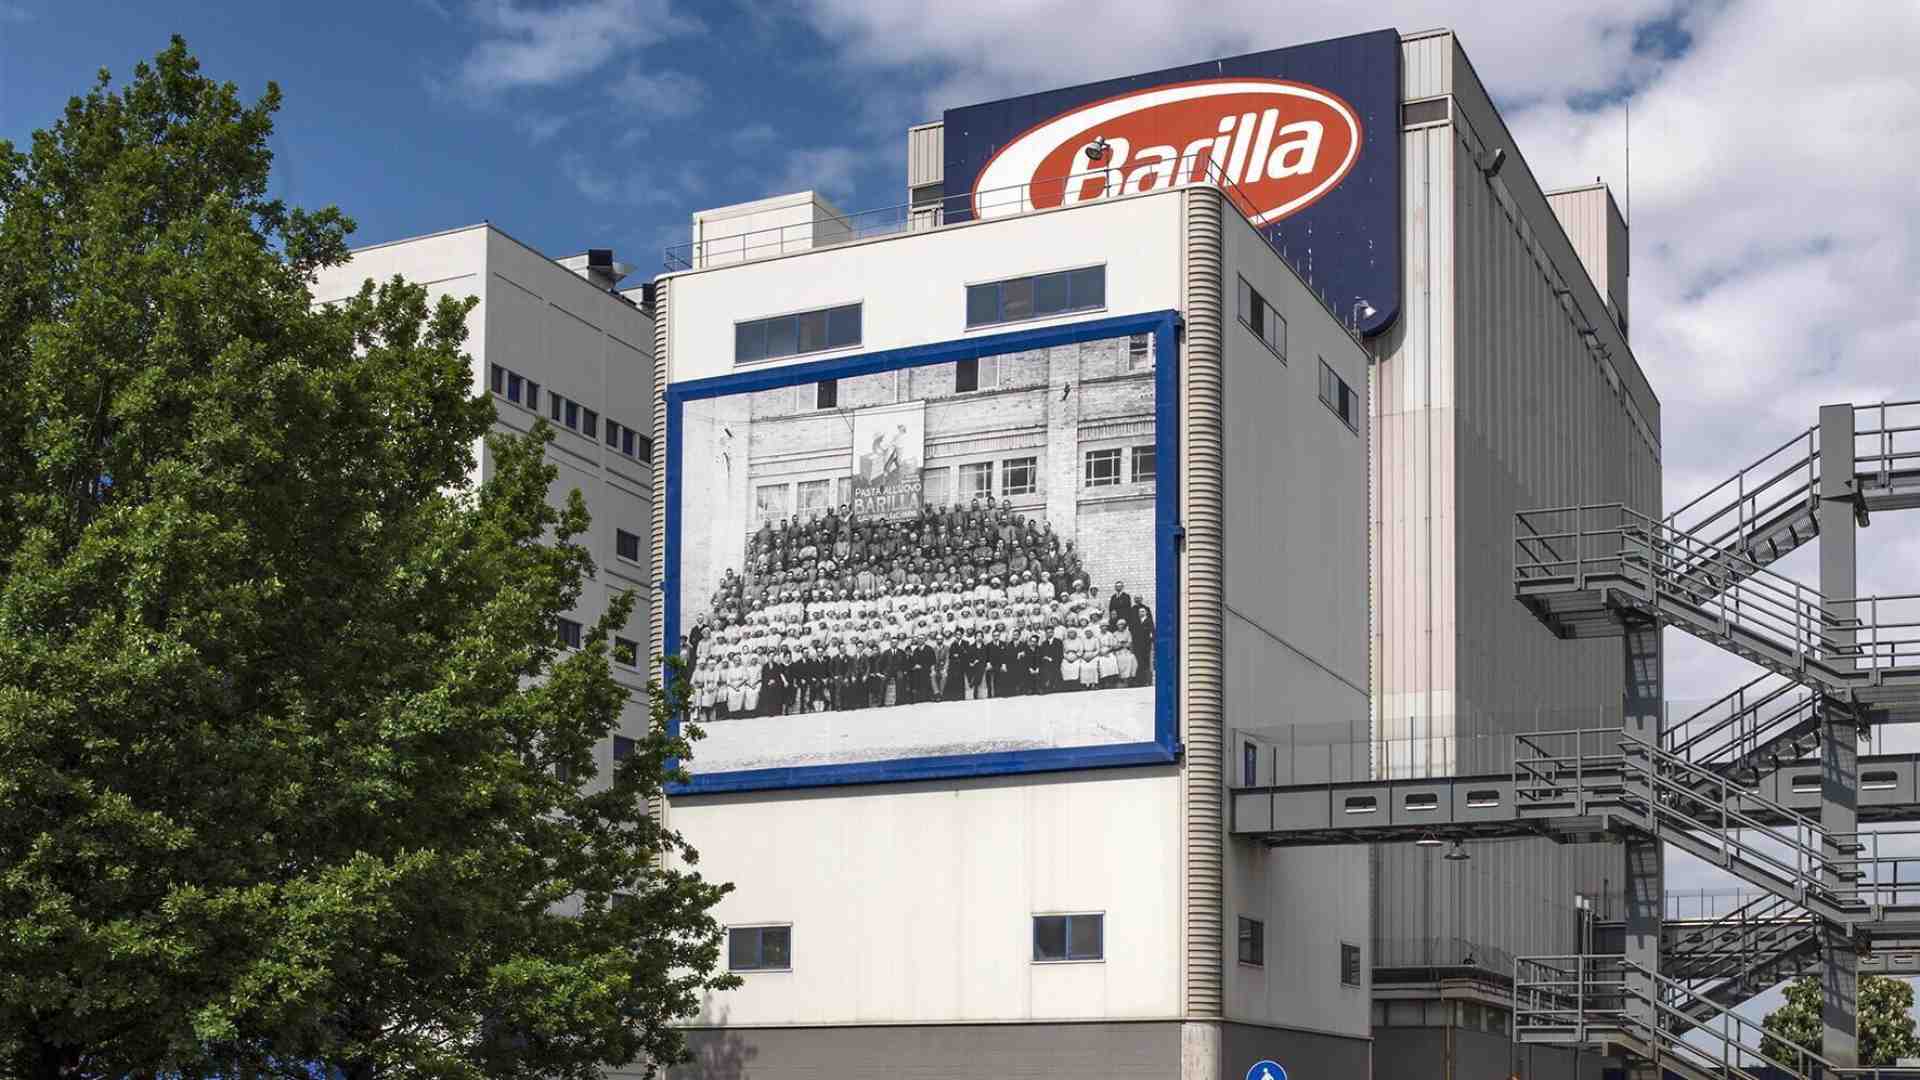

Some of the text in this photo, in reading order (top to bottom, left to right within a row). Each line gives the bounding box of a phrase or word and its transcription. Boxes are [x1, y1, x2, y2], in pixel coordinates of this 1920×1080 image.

[1060, 108, 1325, 207] Barilla
[854, 492, 919, 515] BARILLA
[855, 487, 881, 497] PASTA
